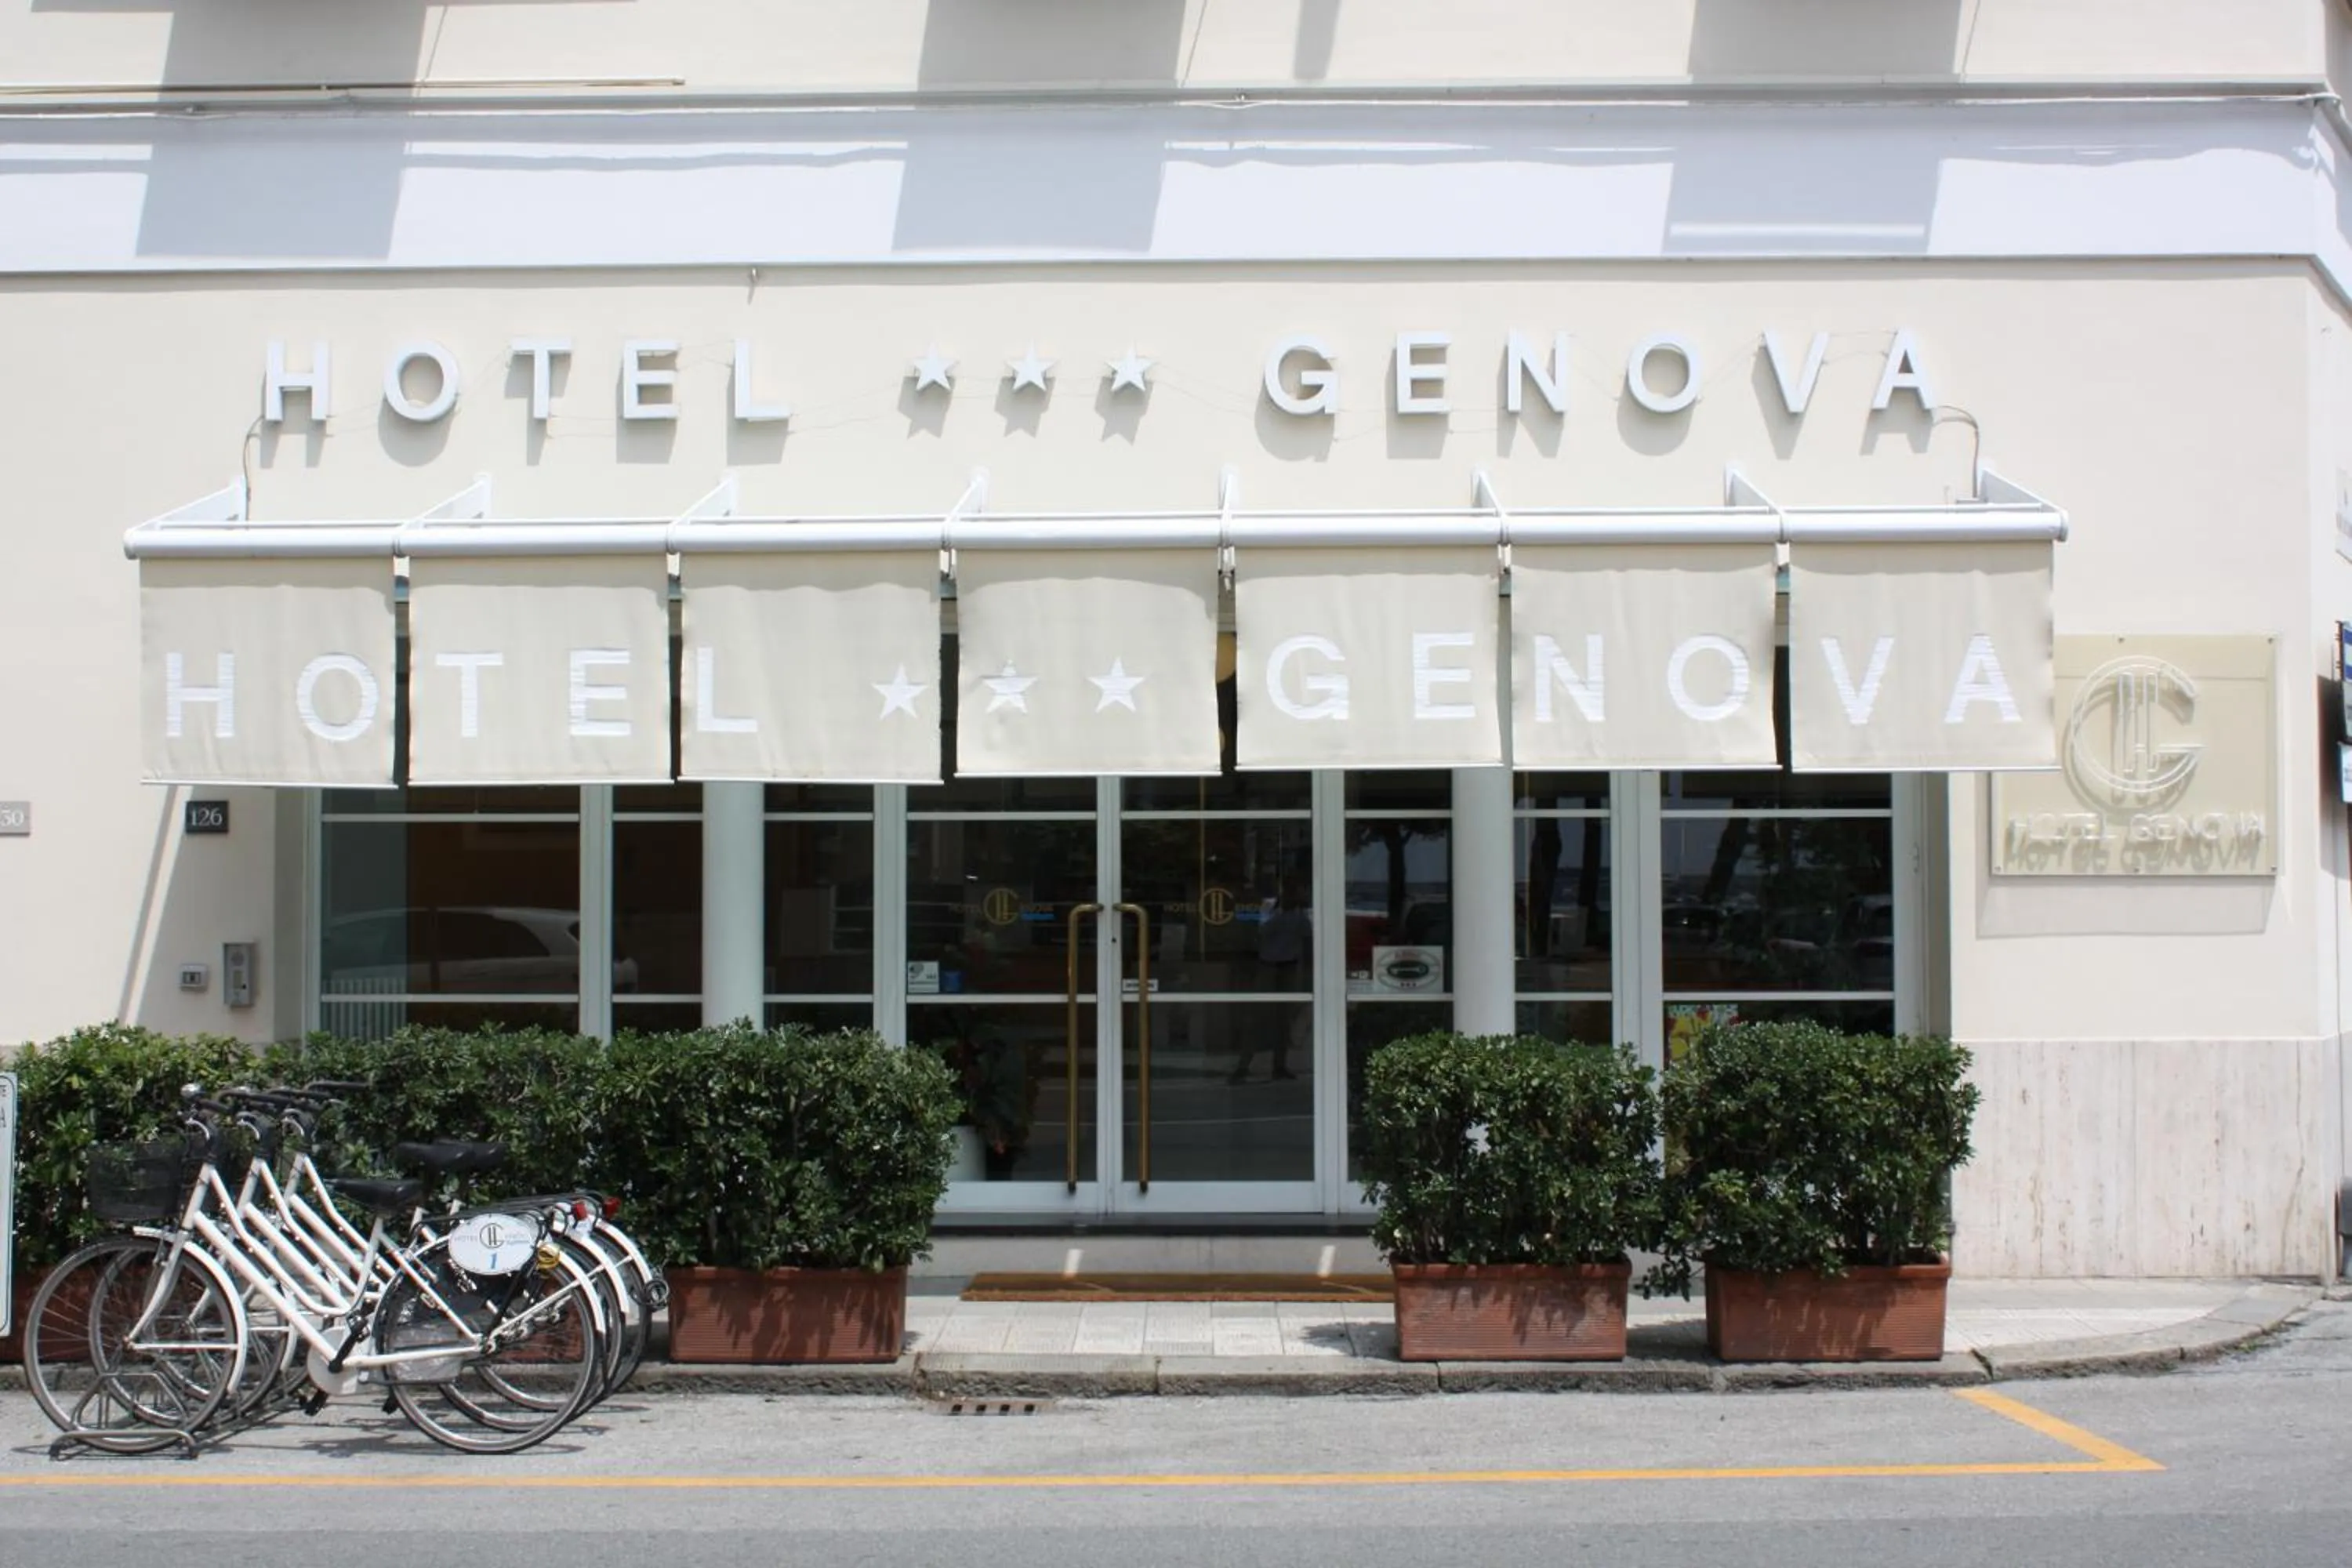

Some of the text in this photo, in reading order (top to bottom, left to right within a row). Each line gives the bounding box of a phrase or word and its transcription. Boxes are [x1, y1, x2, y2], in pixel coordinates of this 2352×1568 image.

[262, 328, 1940, 422] HOTEL GENOVA
[165, 631, 2023, 742] HOTEL GENOVA
[191, 807, 223, 826] 126
